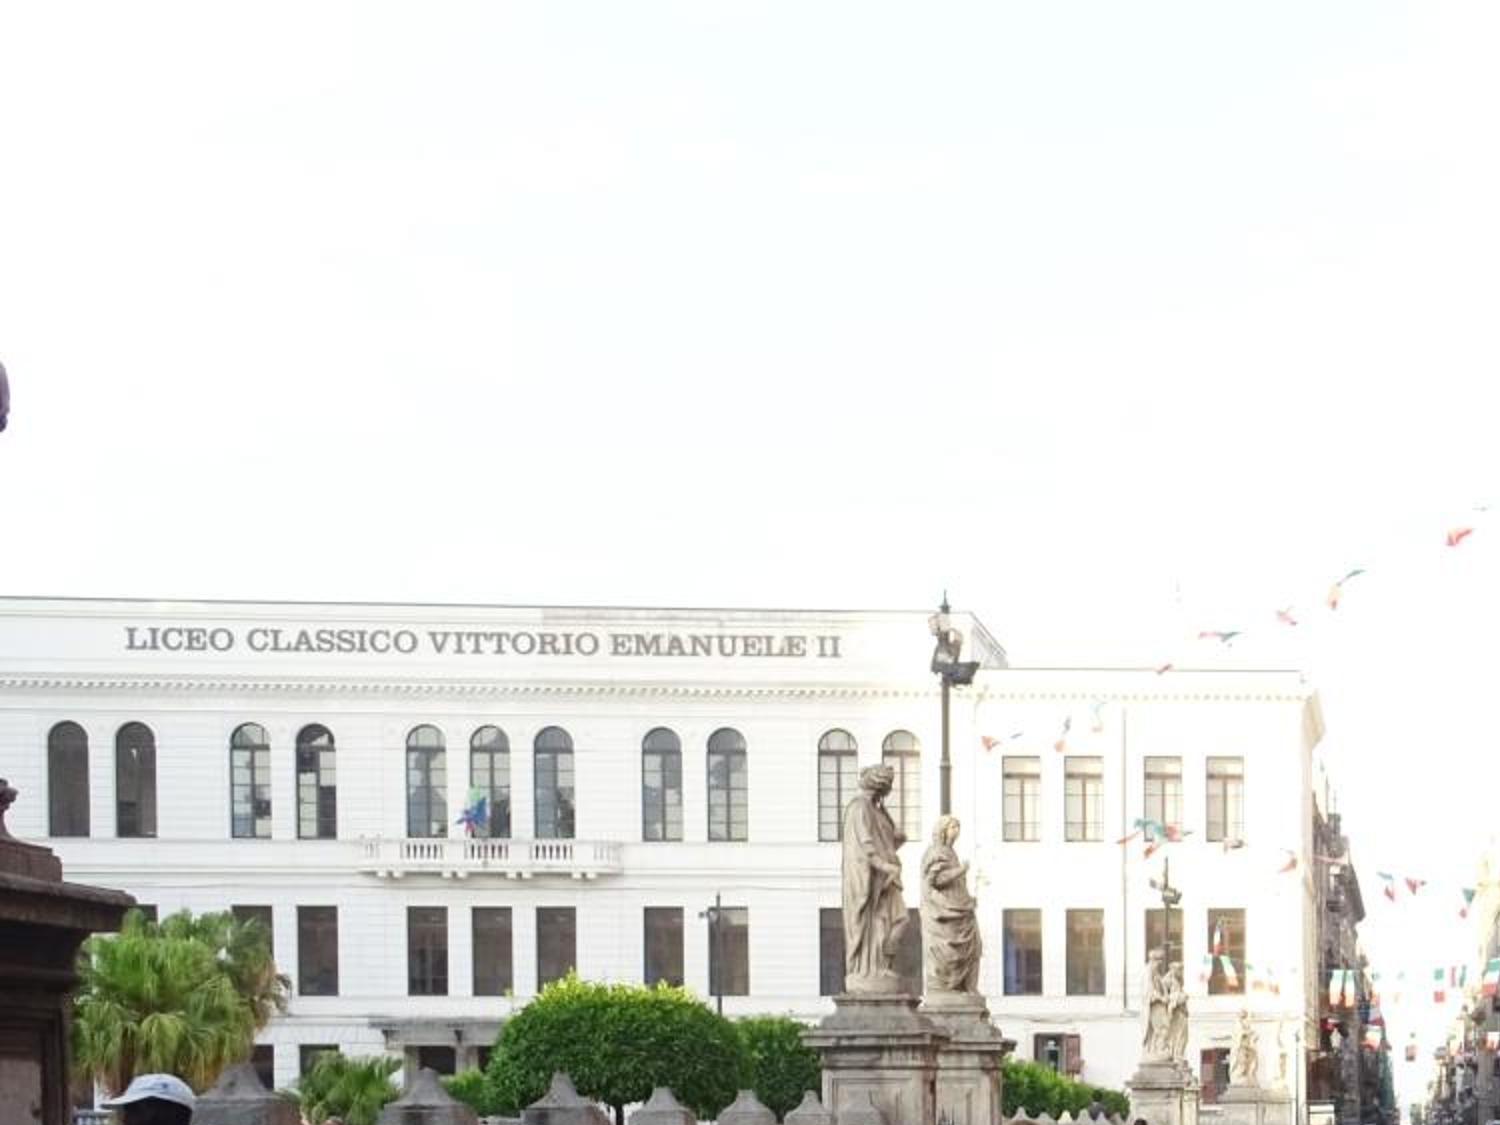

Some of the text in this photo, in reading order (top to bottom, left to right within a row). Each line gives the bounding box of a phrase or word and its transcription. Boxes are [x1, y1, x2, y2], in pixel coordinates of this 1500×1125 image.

[125, 626, 842, 658] LICEO CLASSICO VITTORIO EMANUELE II
